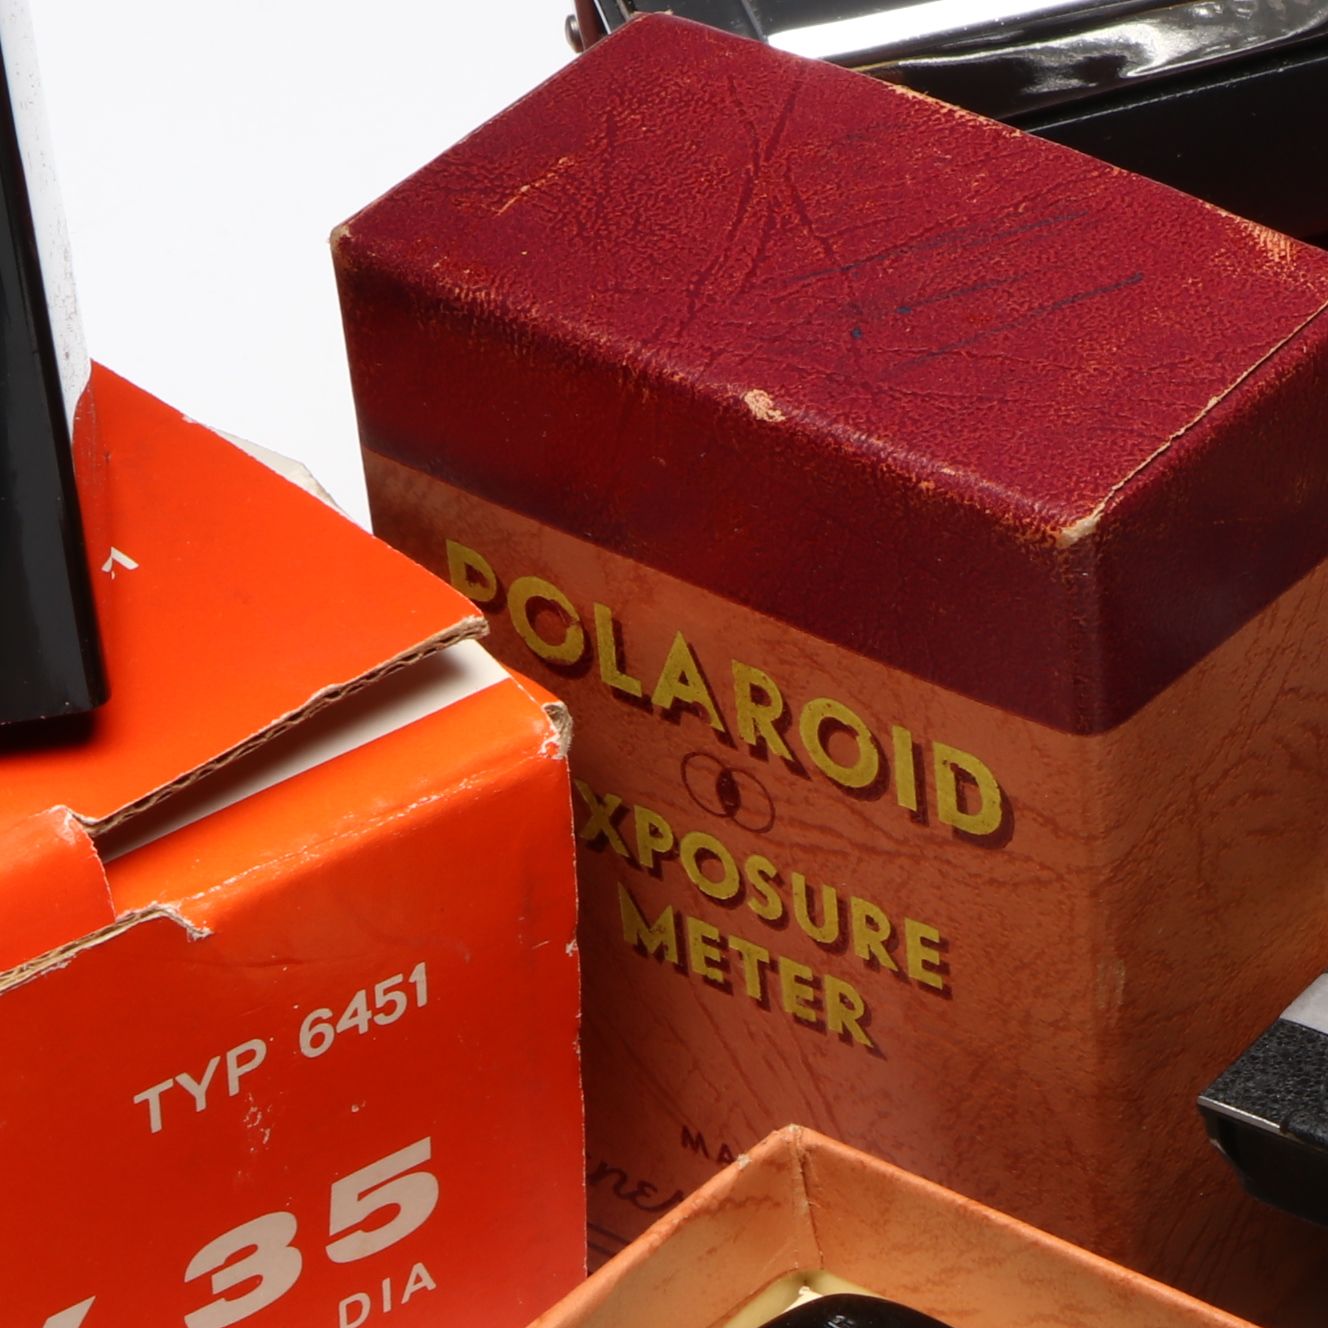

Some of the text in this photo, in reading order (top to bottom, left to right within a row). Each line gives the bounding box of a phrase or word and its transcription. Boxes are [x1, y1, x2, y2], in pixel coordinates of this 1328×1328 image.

[446, 539, 1008, 842] POLAROID
[572, 776, 945, 992] XPOSURE
[617, 881, 876, 1050] METER
[133, 962, 429, 1134] TYP 6451
